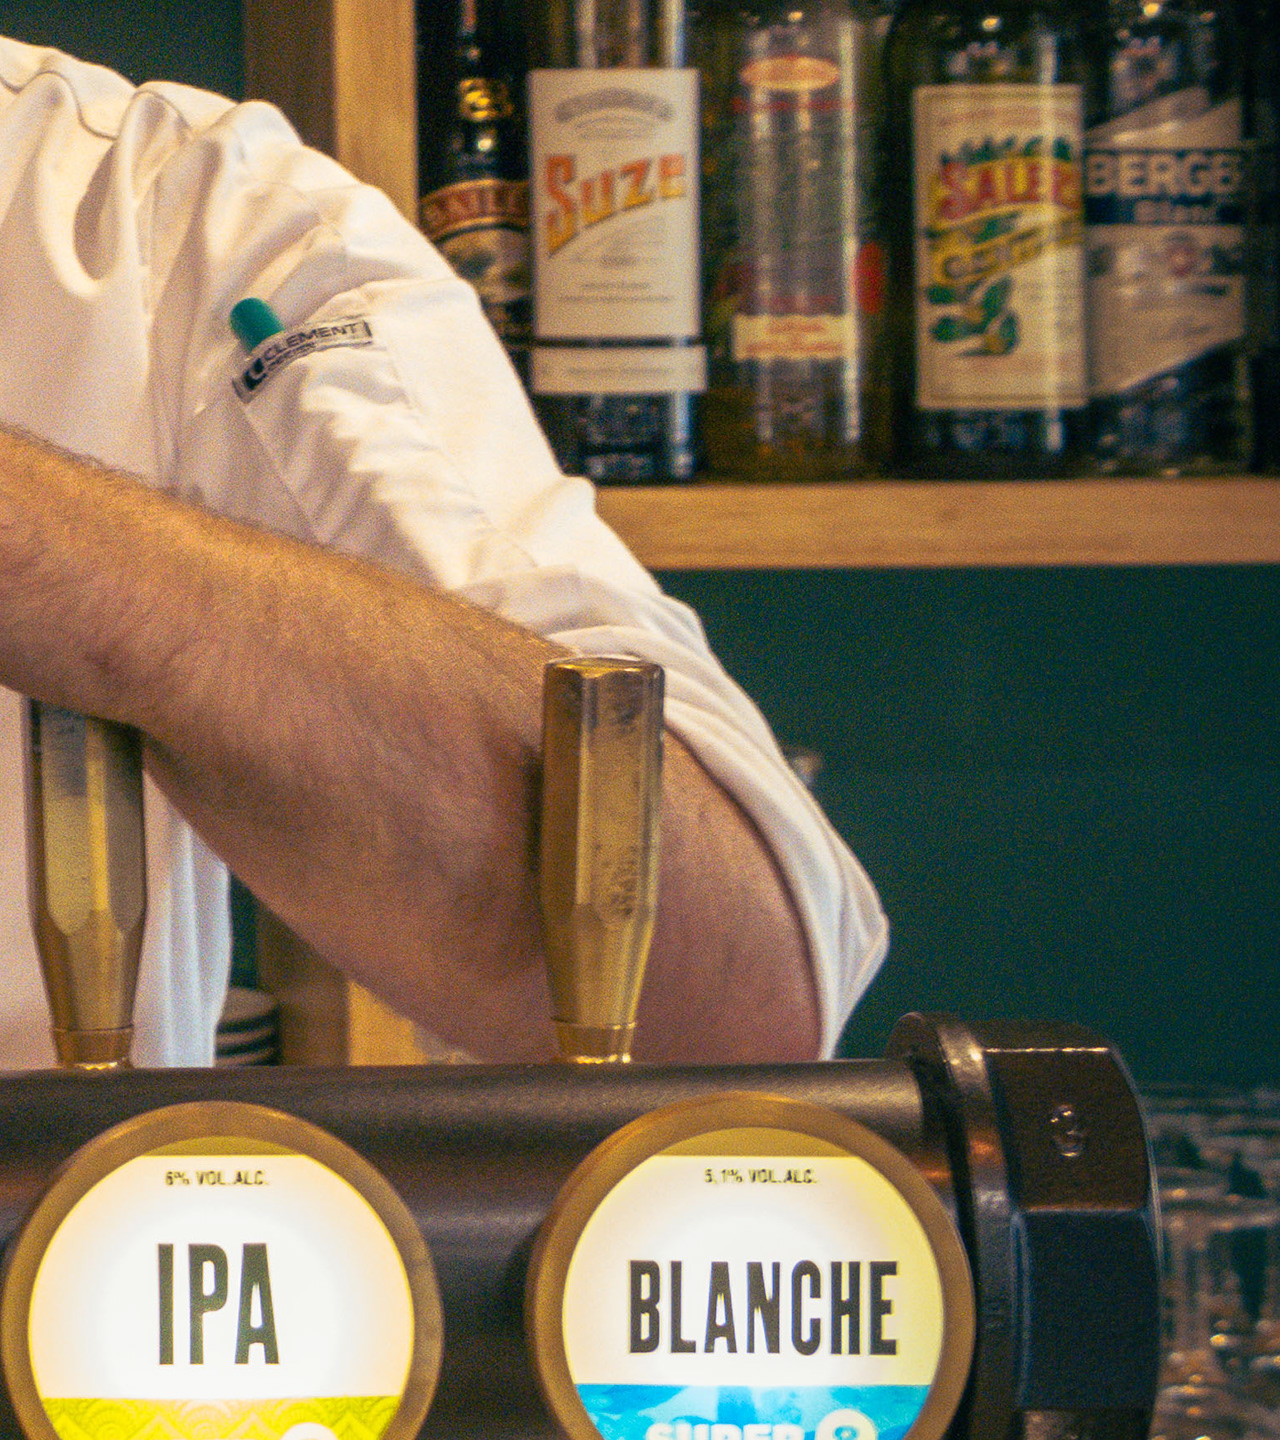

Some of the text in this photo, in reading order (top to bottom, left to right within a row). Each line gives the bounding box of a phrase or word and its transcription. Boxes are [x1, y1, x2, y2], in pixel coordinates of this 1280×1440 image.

[263, 322, 359, 362] CLEMENT
[164, 1169, 190, 1186] 6%
[157, 1242, 280, 1365] IPA
[627, 1259, 899, 1357] BLANCHE
